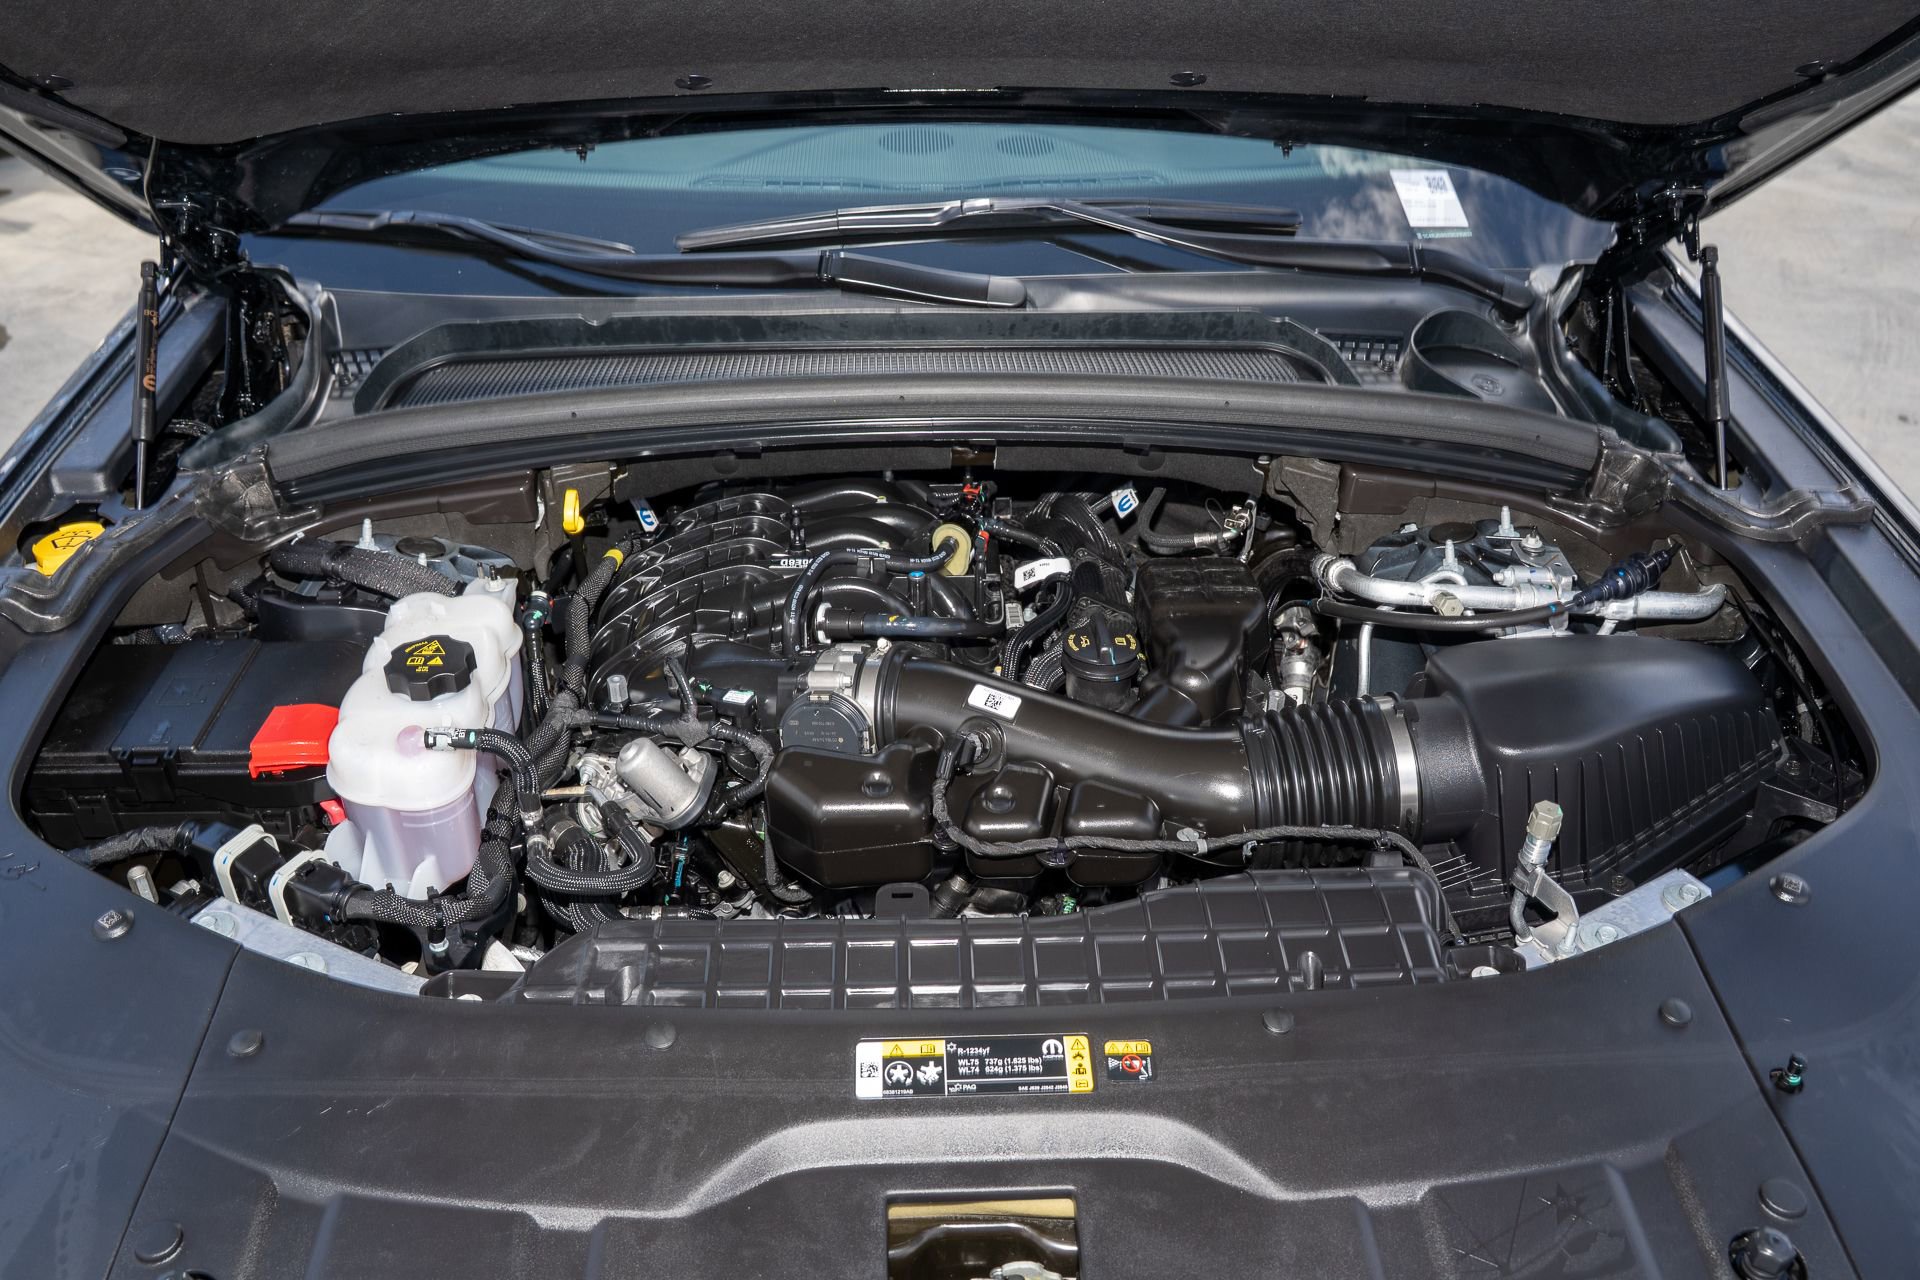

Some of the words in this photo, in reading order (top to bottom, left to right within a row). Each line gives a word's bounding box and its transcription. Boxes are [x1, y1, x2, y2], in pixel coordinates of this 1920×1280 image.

[957, 1046, 990, 1056] R-1234yf
[957, 1058, 980, 1066] WL75
[985, 1057, 1003, 1066] 737g
[957, 1066, 980, 1074] WL74
